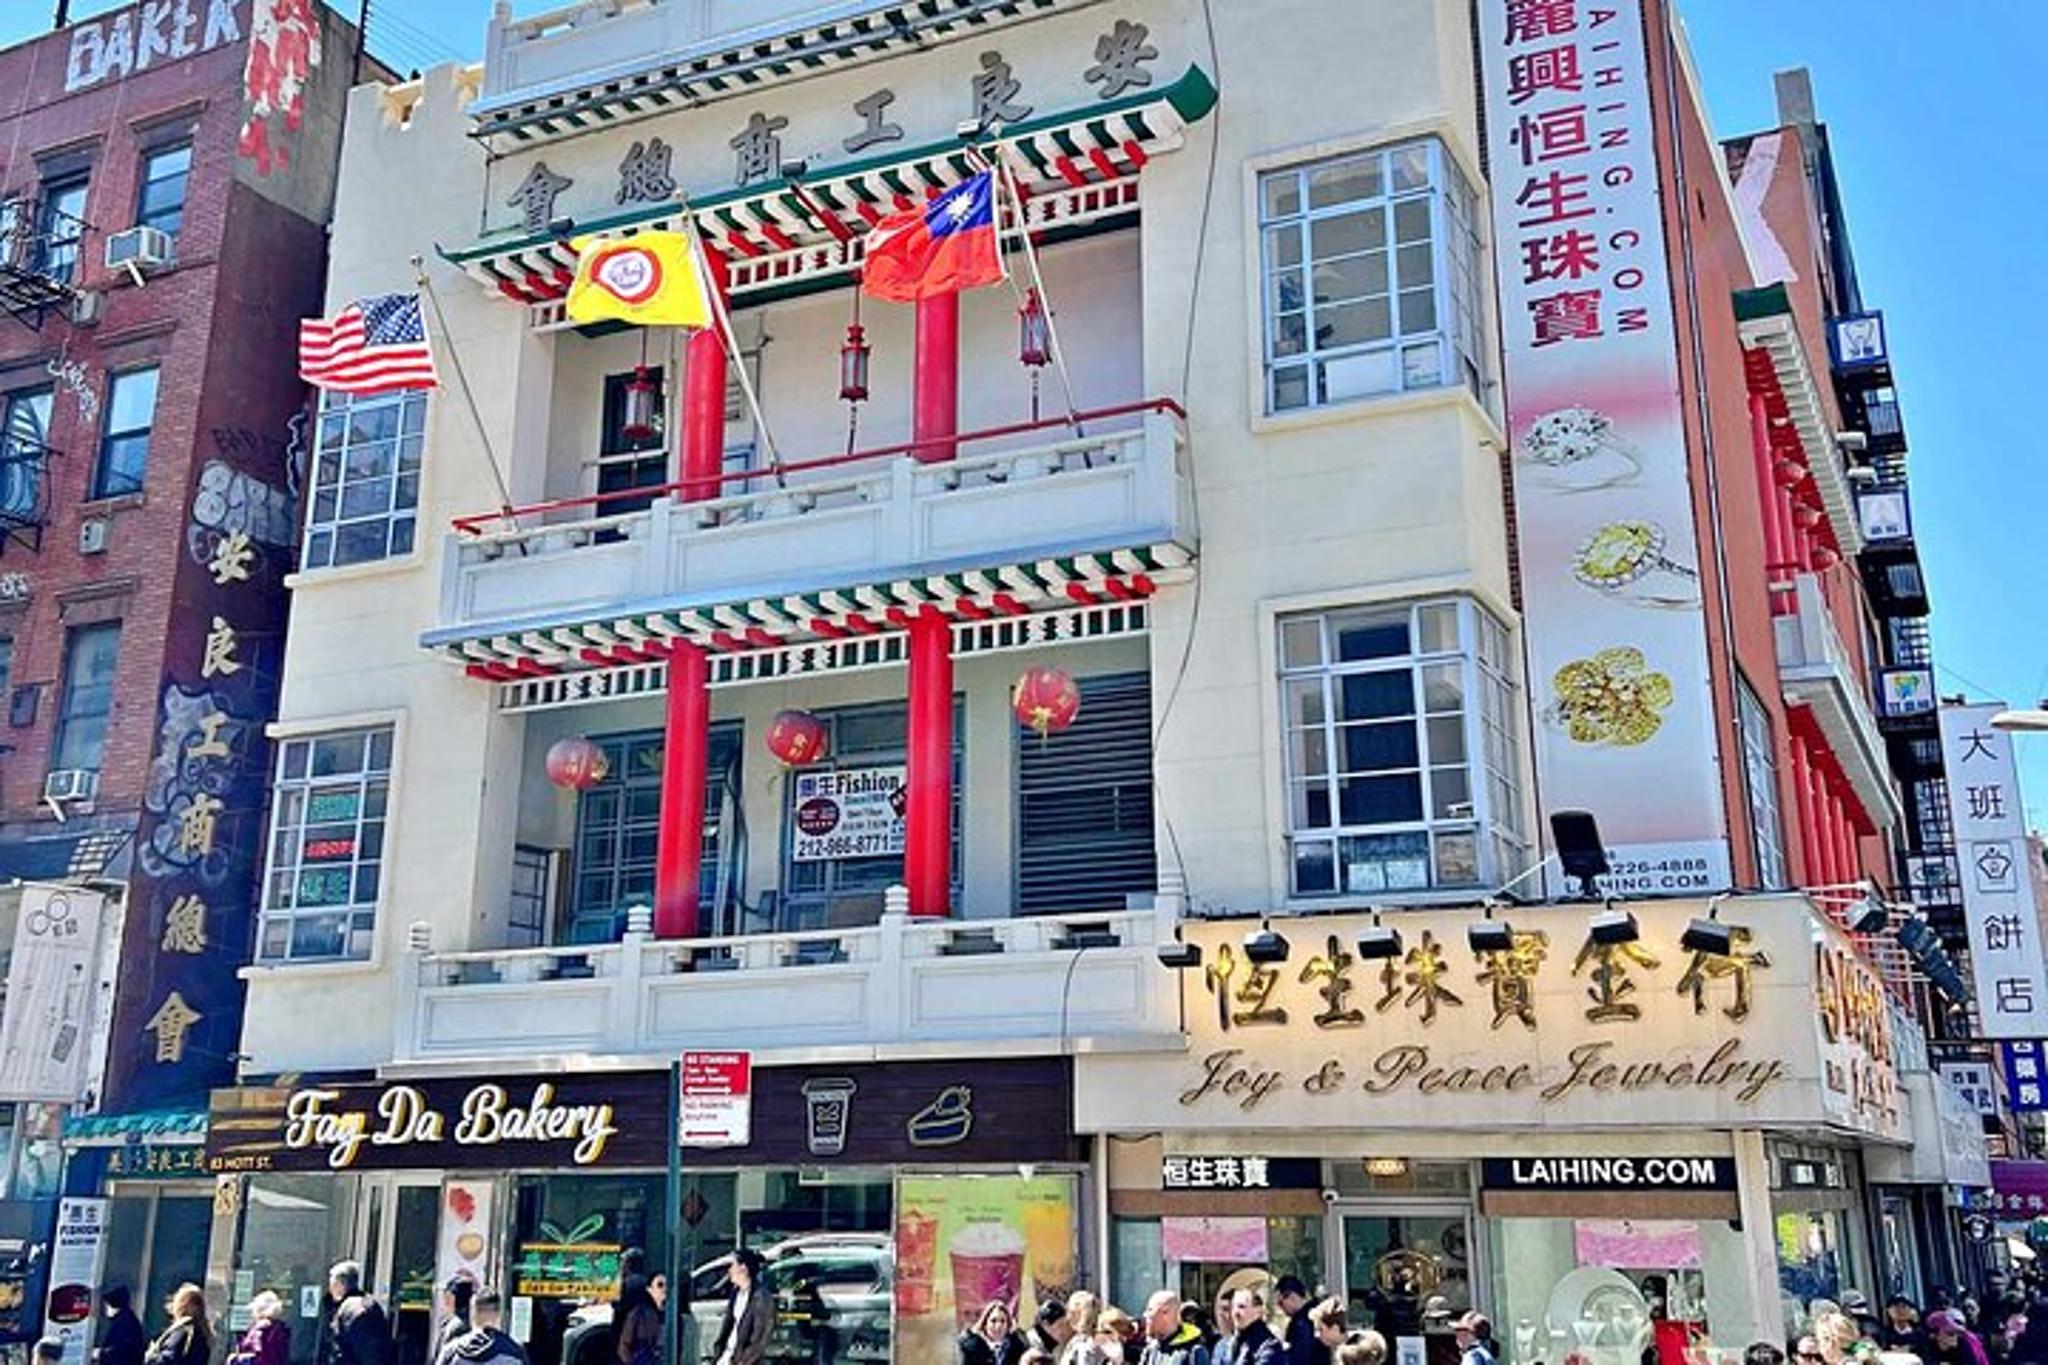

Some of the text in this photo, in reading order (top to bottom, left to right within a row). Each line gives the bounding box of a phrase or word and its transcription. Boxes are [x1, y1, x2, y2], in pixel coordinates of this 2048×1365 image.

[836, 771, 899, 794] Fishion
[1958, 727, 2034, 1015] 大班餅店
[1180, 1049, 1283, 1109] Joy
[1303, 1060, 1346, 1093] &
[1363, 1045, 1532, 1093] Peace
[1540, 1038, 1784, 1102] Jewelry
[372, 1085, 445, 1145] Da
[454, 1083, 618, 1164] Bakery
[225, 1157, 254, 1169] MOTT
[1163, 1158, 1269, 1187] 恒生珠寶
[1512, 1159, 1715, 1184] LAIHING.COM
